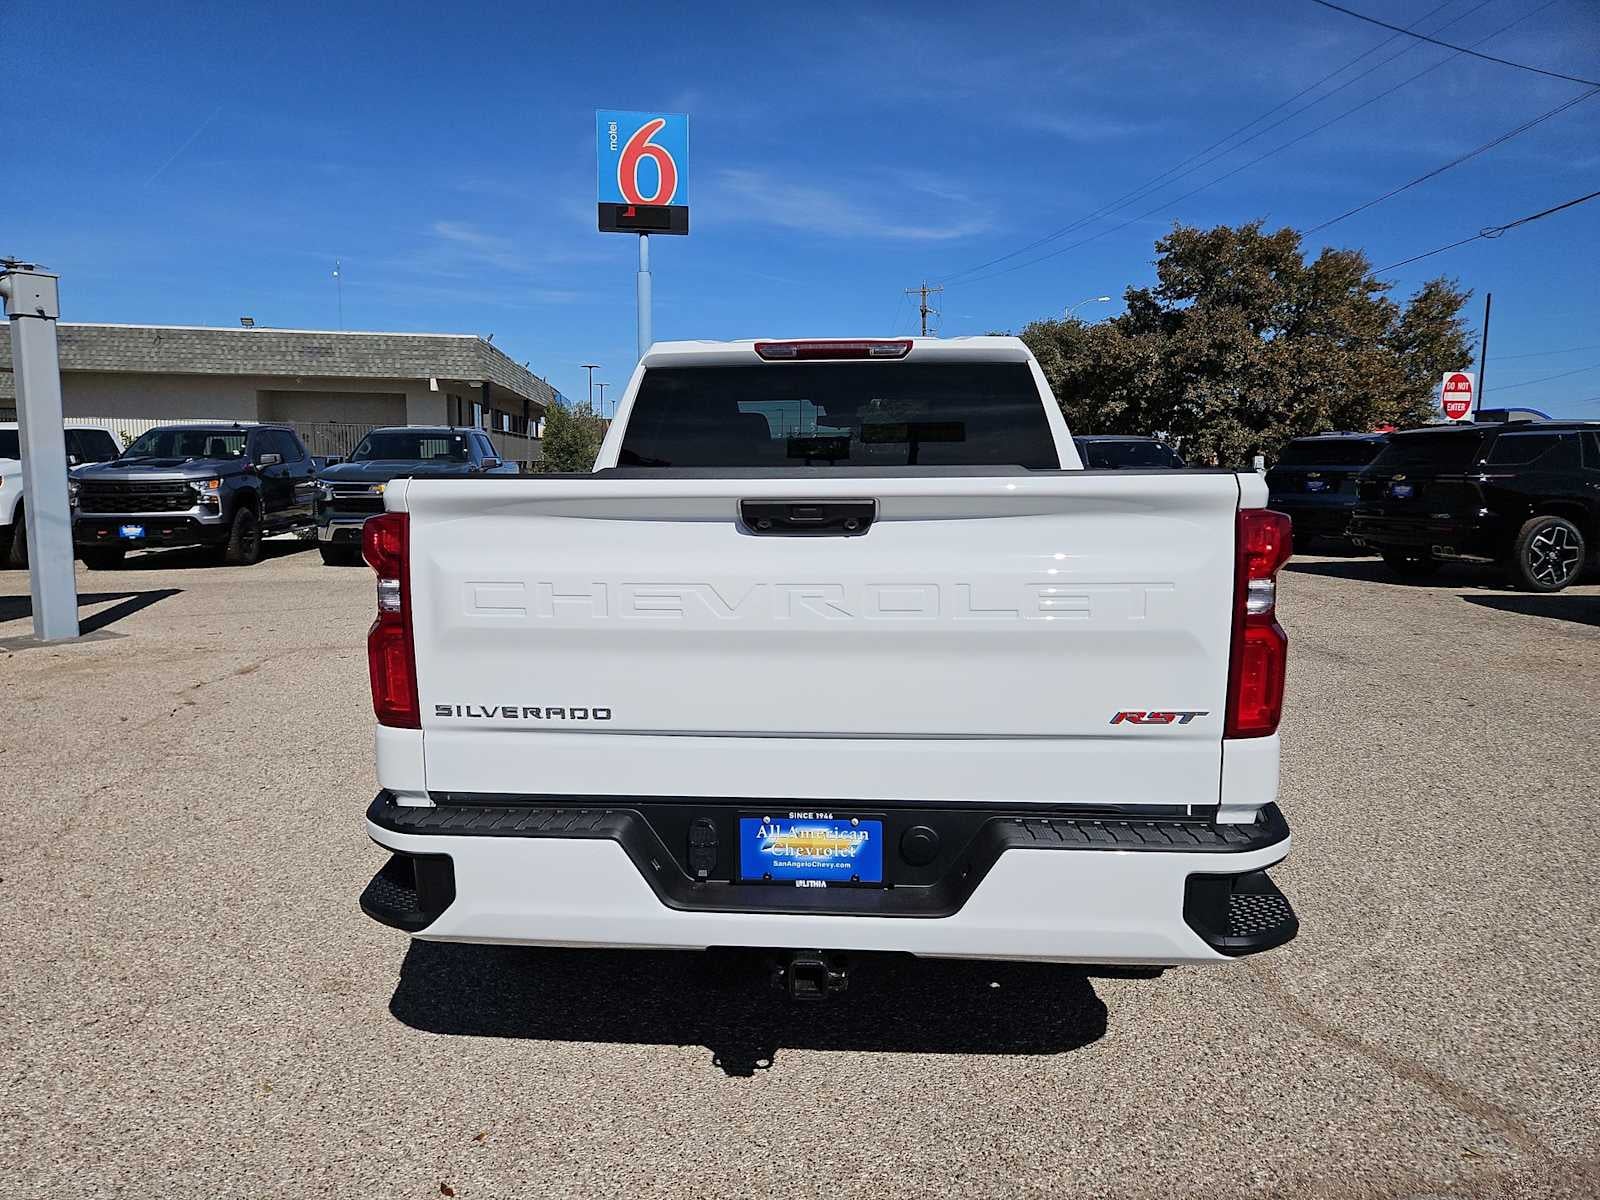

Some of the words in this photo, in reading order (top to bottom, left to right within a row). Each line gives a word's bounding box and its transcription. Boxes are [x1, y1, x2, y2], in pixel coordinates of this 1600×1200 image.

[608, 120, 617, 151] motel
[617, 118, 678, 206] 6
[1446, 382, 1456, 391] DO
[1457, 382, 1469, 391] NOT
[1447, 403, 1466, 411] ENTER
[463, 581, 1176, 620] CHEVROLET
[434, 704, 612, 720] SILVERADO
[1109, 711, 1211, 725] RST
[815, 812, 834, 820] 1946
[756, 824, 782, 839] All
[788, 826, 869, 841] American
[770, 841, 858, 858] Chevrolet
[772, 860, 851, 869] SanAngeloChevy.com
[801, 880, 827, 888] LITHIA
